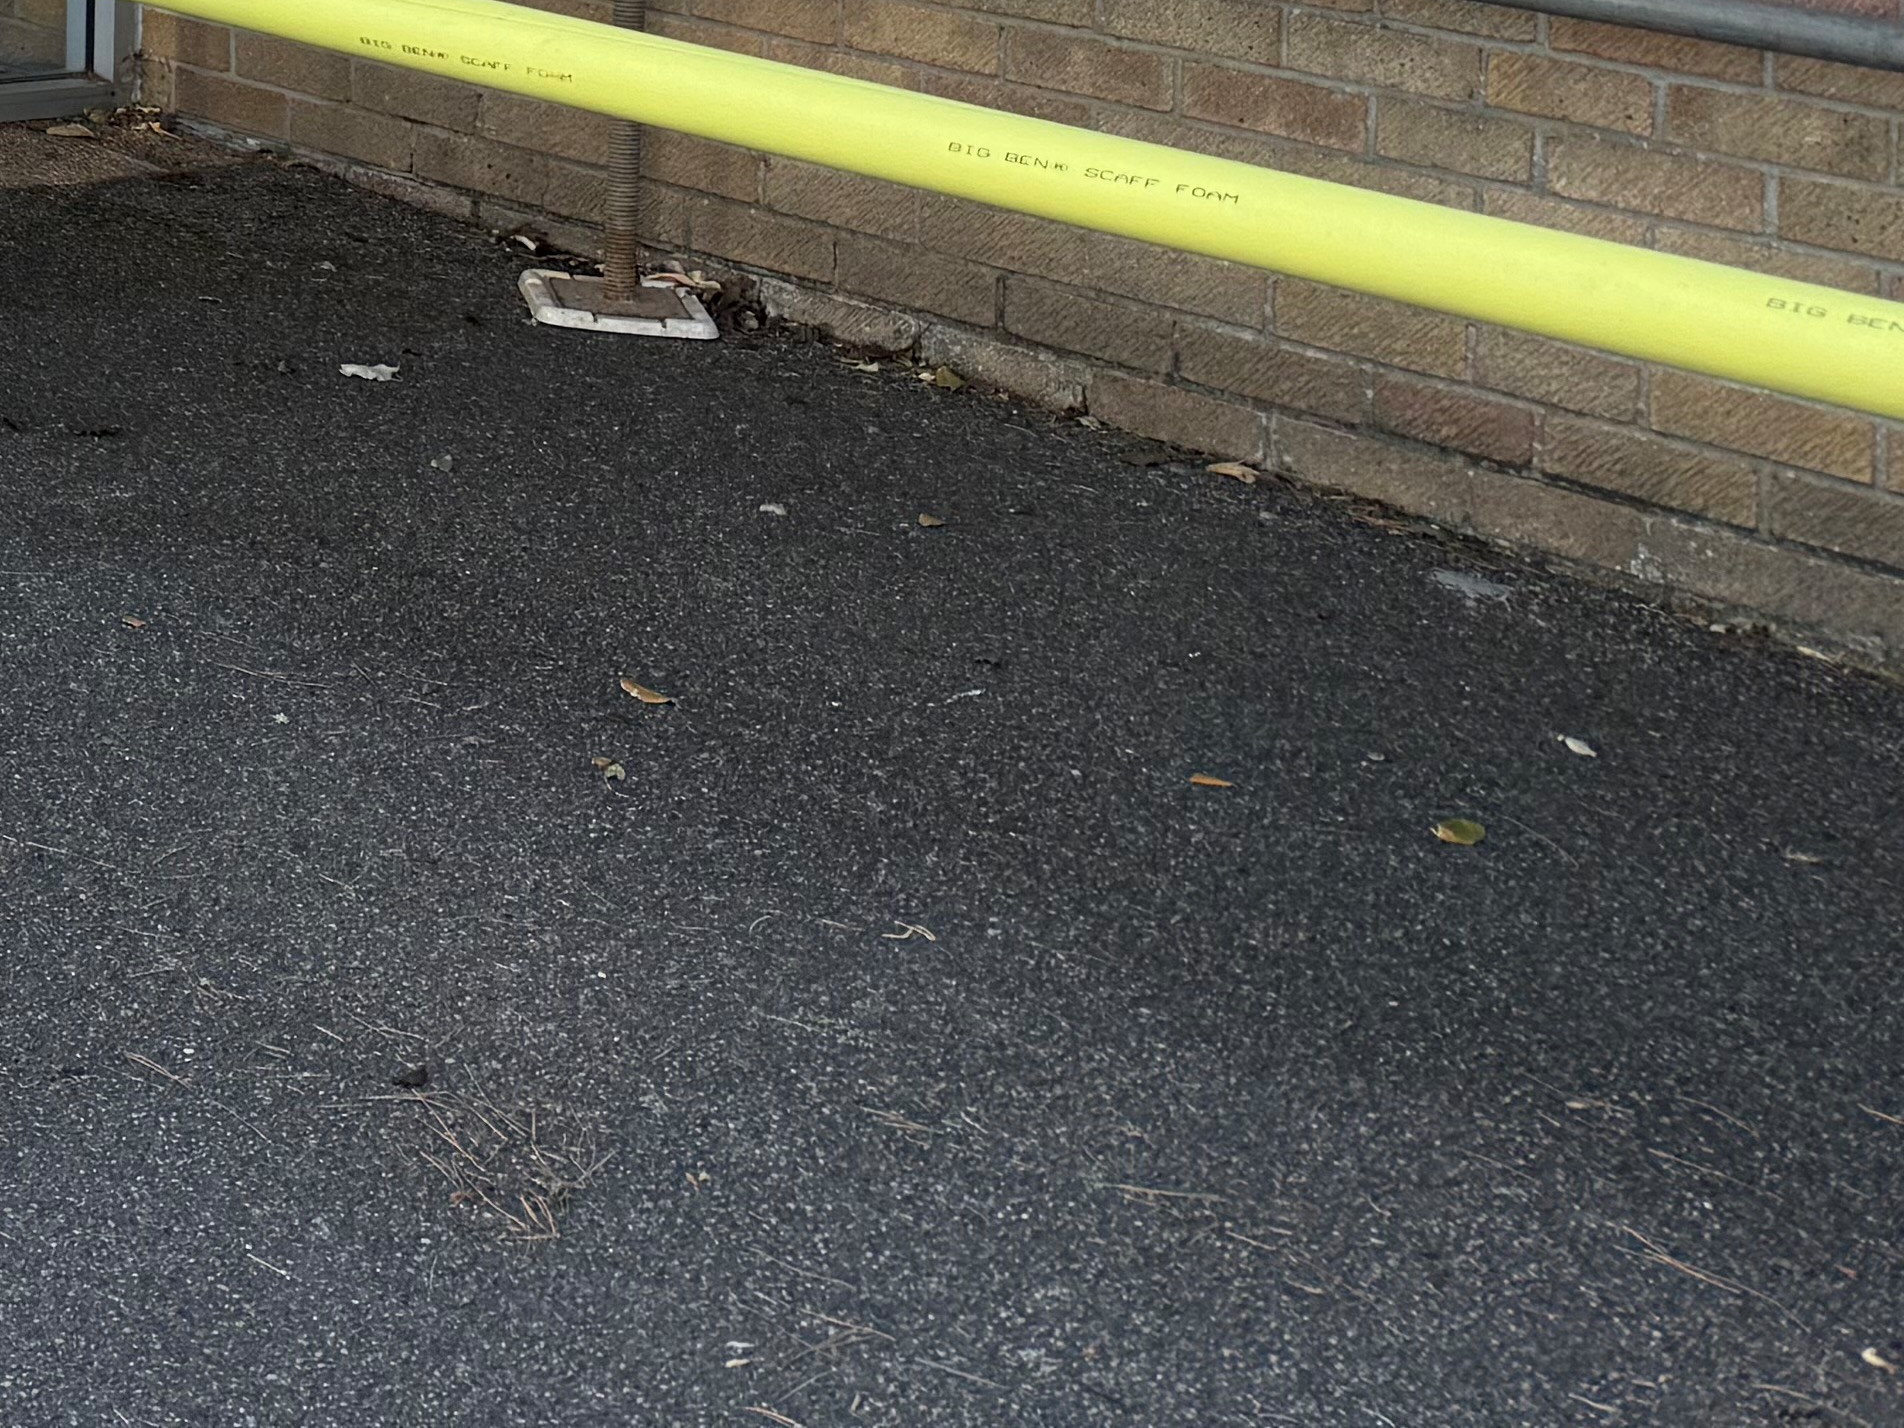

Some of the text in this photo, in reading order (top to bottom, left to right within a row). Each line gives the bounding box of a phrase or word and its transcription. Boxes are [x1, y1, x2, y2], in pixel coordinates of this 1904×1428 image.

[948, 141, 991, 159] BIG
[1084, 167, 1160, 188] SCAFF
[1175, 184, 1239, 204] FOAM
[1765, 297, 1829, 319] BIG
